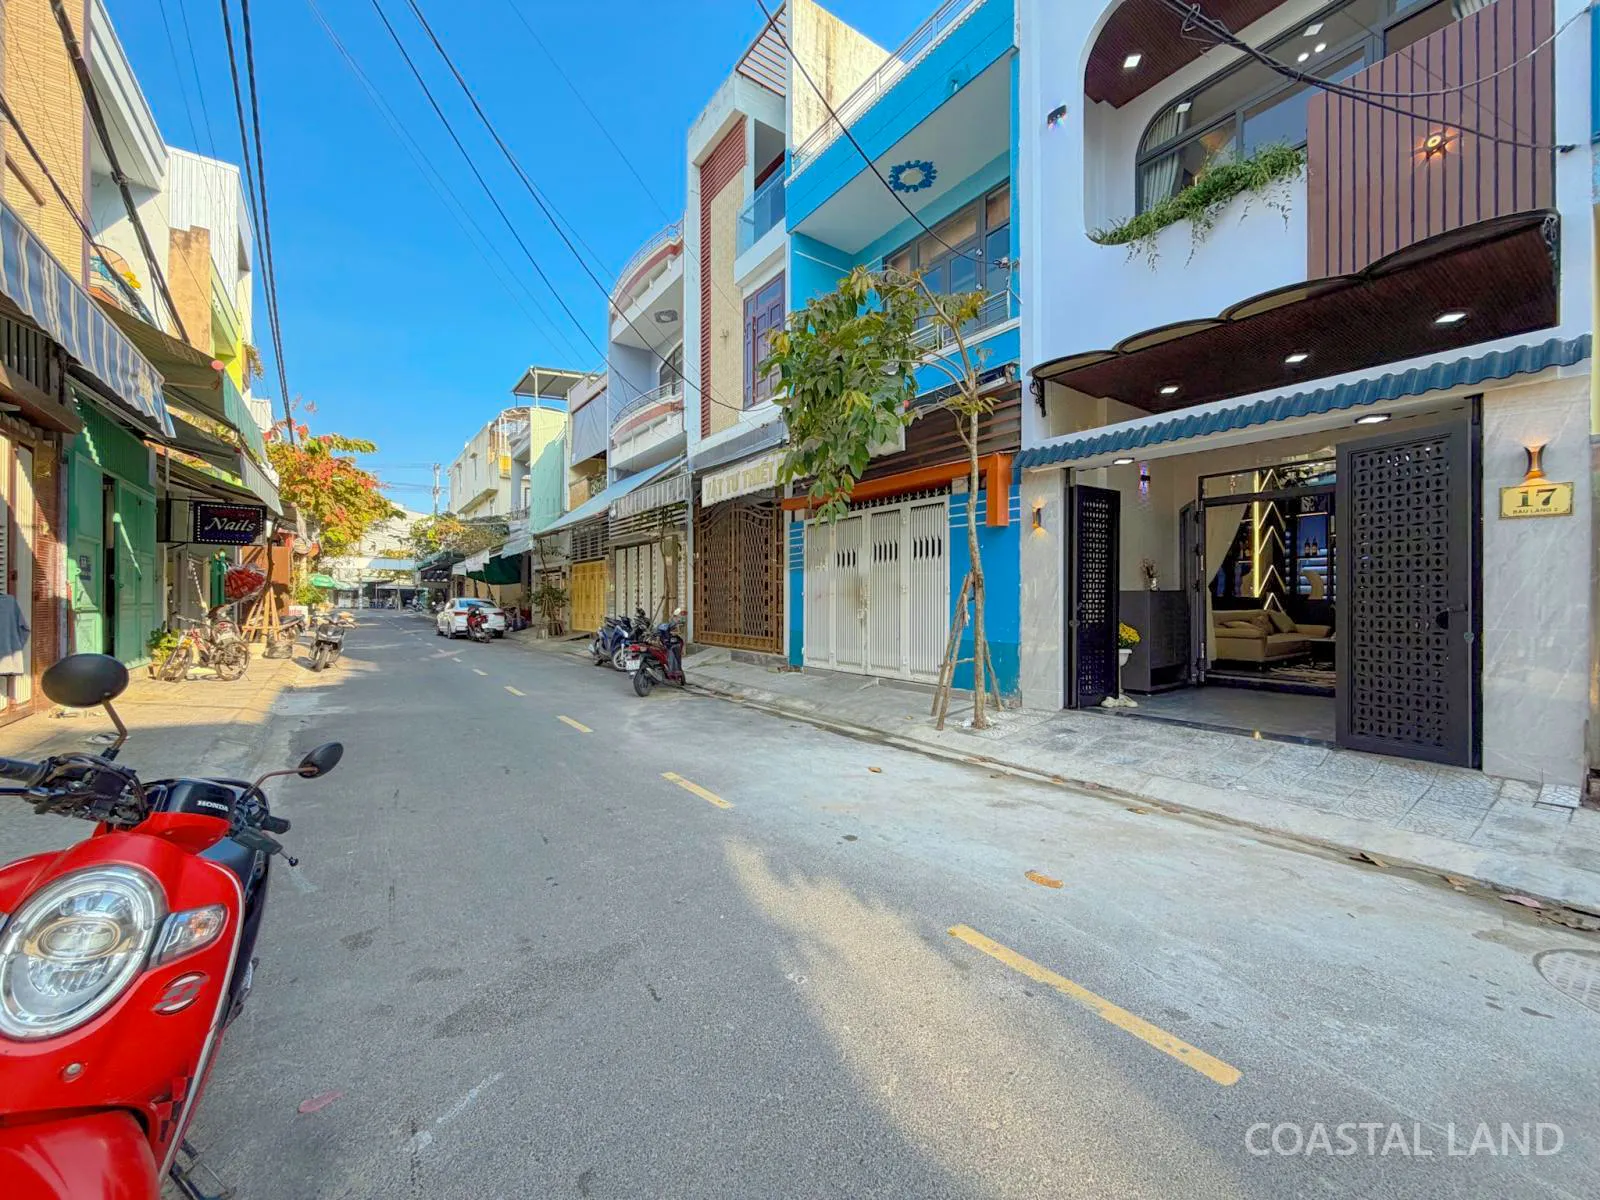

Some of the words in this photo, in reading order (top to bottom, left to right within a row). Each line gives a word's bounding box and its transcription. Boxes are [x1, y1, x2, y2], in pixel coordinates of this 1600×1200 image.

[1516, 488, 1557, 507] 17
[204, 517, 256, 531] Nails
[201, 800, 228, 812] HONDA
